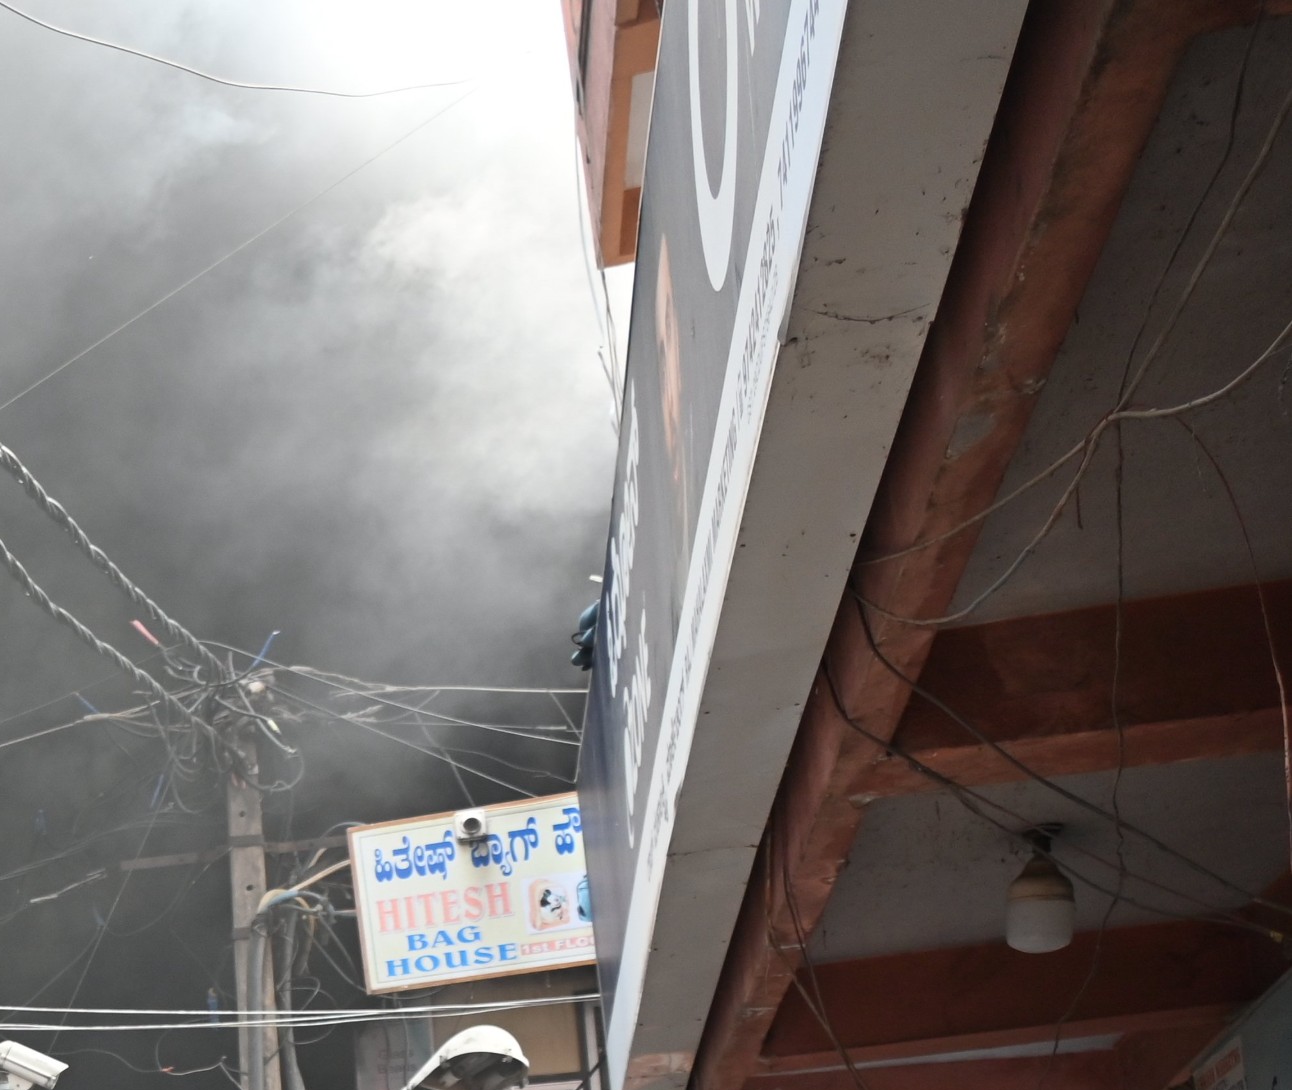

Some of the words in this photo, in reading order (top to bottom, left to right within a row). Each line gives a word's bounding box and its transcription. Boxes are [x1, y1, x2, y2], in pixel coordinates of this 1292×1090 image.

[377, 881, 513, 933] HITESH
[407, 925, 482, 951] BAG
[386, 942, 519, 977] HOUSE
